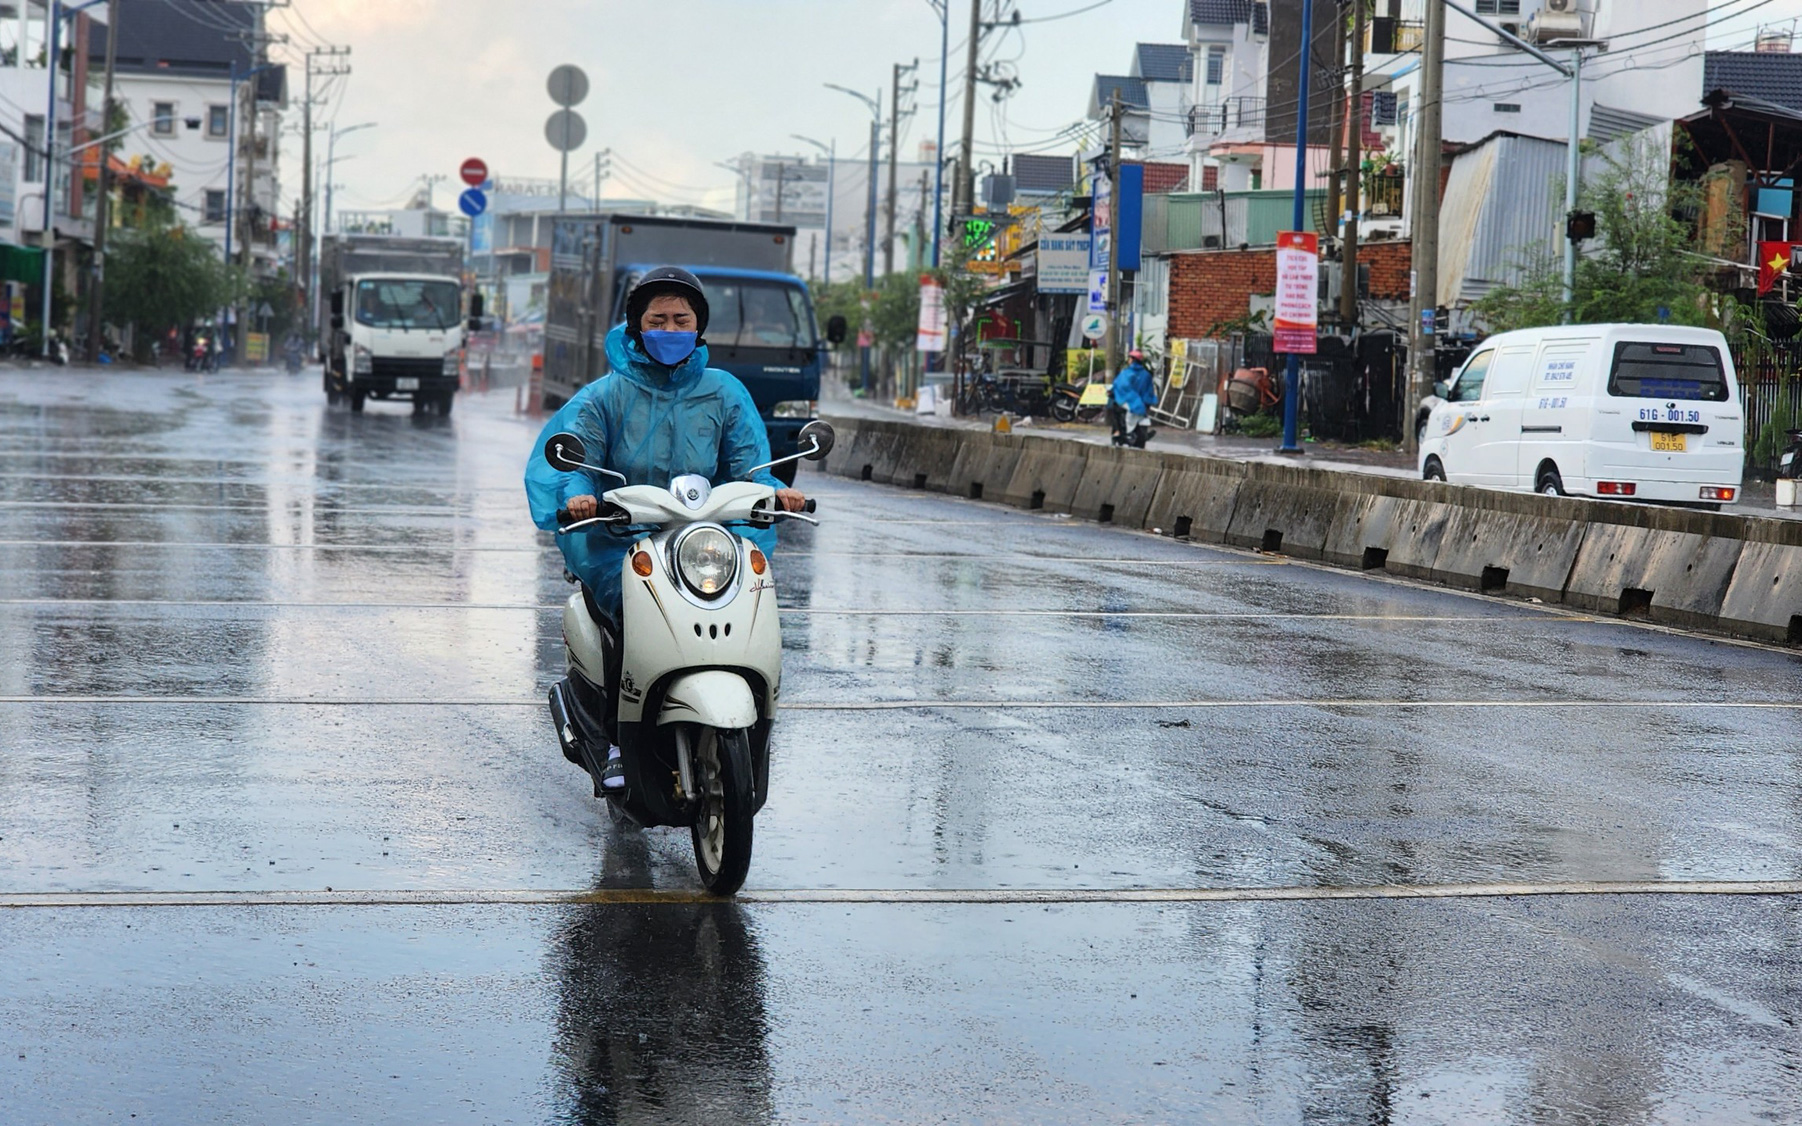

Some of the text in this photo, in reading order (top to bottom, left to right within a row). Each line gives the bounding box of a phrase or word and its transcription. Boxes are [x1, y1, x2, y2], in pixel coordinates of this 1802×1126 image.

[1640, 408, 1658, 420] 61G
[1668, 409, 1700, 422] 001.50
[1655, 442, 1683, 451] 001.50
